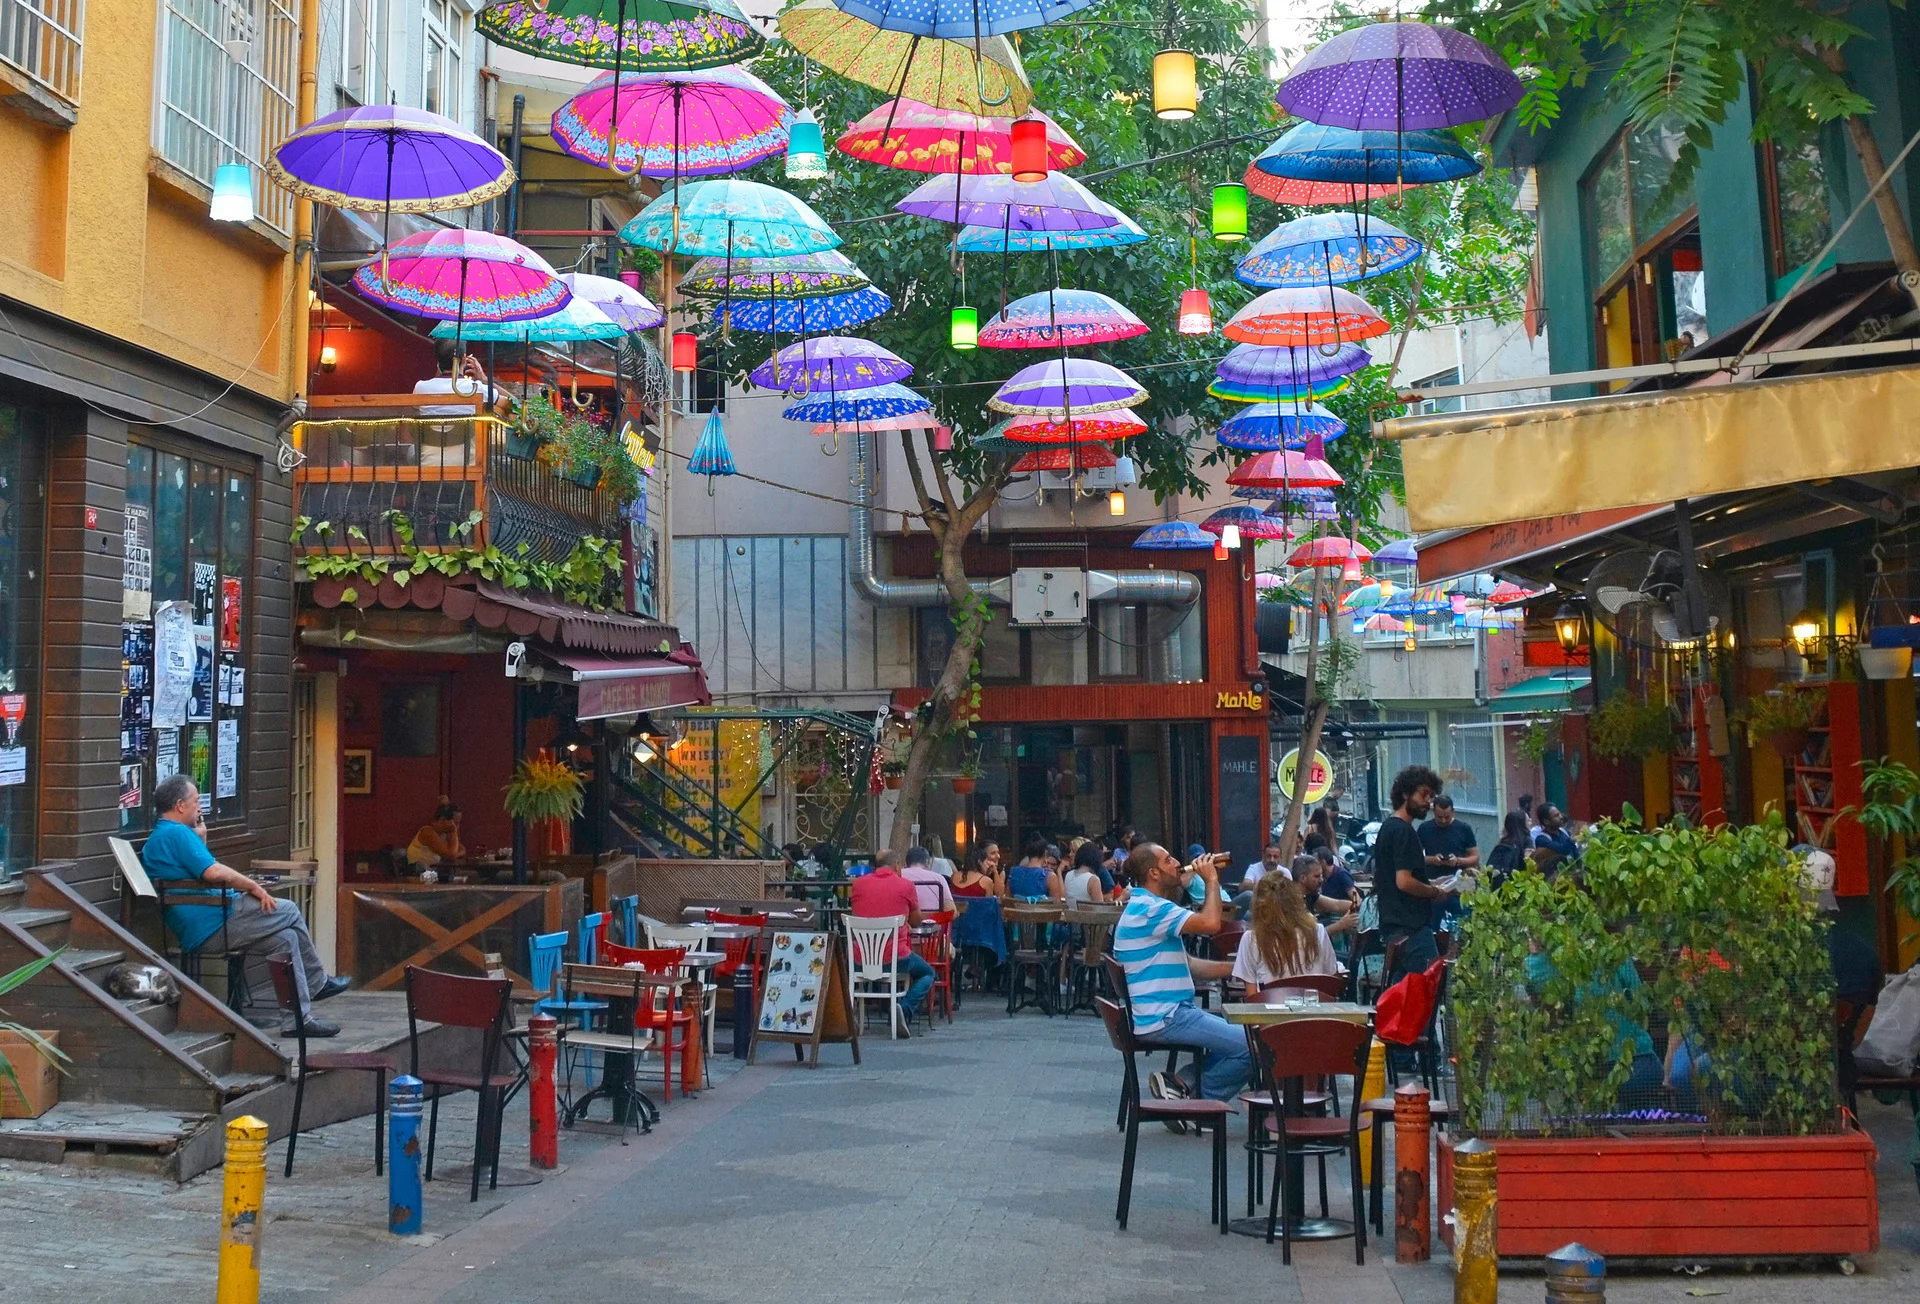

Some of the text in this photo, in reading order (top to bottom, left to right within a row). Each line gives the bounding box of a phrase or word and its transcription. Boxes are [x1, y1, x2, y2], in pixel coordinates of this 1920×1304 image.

[1216, 691, 1262, 710] Mahle
[1223, 761, 1257, 773] MAHLE
[1285, 766, 1323, 784] MLE
